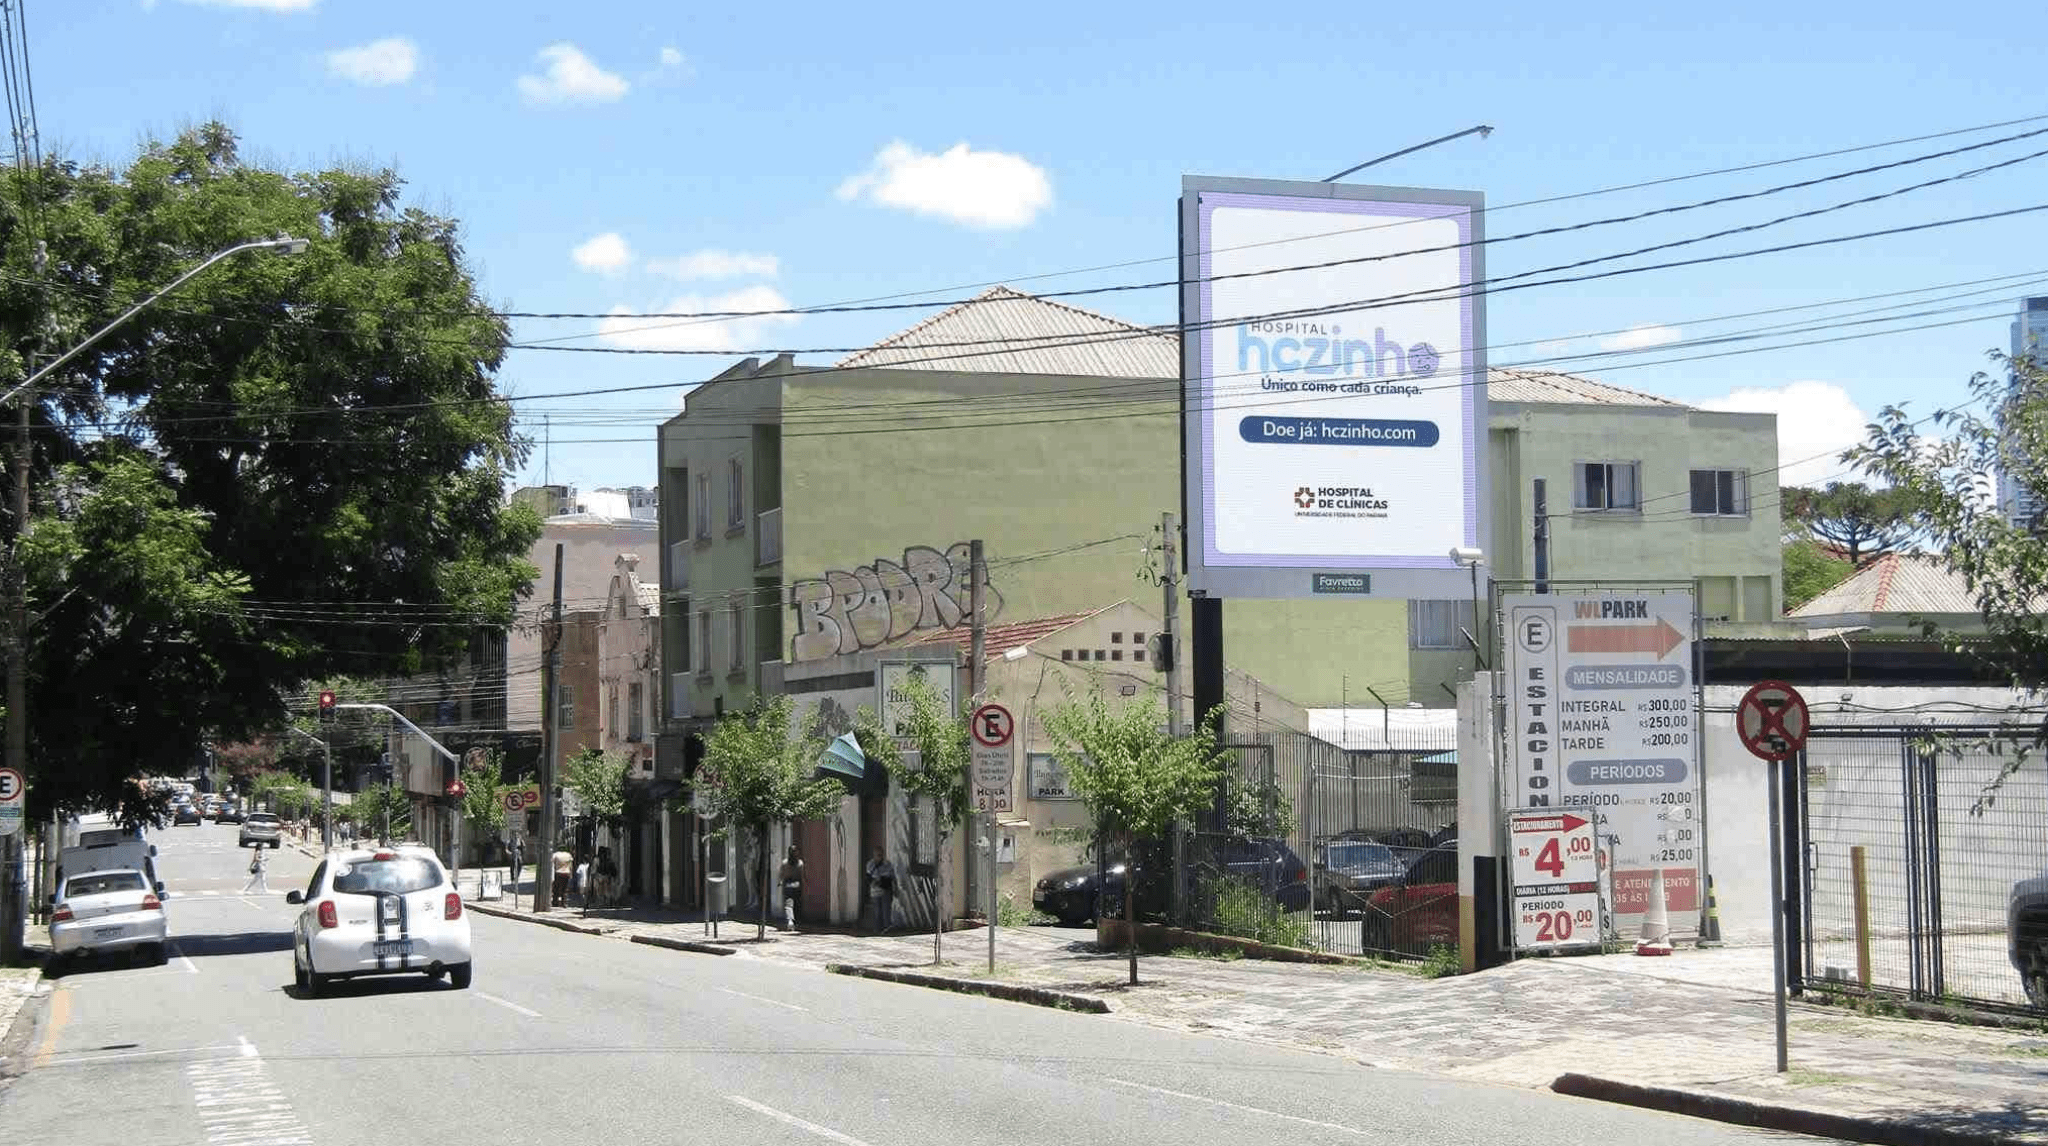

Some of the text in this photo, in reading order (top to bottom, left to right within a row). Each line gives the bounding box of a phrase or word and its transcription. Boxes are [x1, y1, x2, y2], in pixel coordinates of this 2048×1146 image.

[1251, 322, 1328, 335] HOSPITAL
[1261, 375, 1422, 397] Único como cada criança.
[1263, 421, 1416, 441] Doe já: hczinho.com
[1318, 487, 1374, 497] HOSPITAL
[1318, 497, 1388, 509] DE CLÍNICAS
[1319, 576, 1364, 587] Favretto
[1527, 623, 1543, 645] E
[1573, 669, 1679, 685] MENSALIDADE
[1561, 700, 1626, 712] INTEGRAL
[1561, 716, 1610, 731] MANHÃ
[1562, 738, 1605, 750] TARDE
[1590, 763, 1665, 779] PERÍODOS
[1038, 788, 1064, 796] PARK
[1563, 791, 1620, 806] PERÍODO
[1624, 878, 1690, 890] ATENENTO
[1522, 900, 1564, 911] PERÍODO
